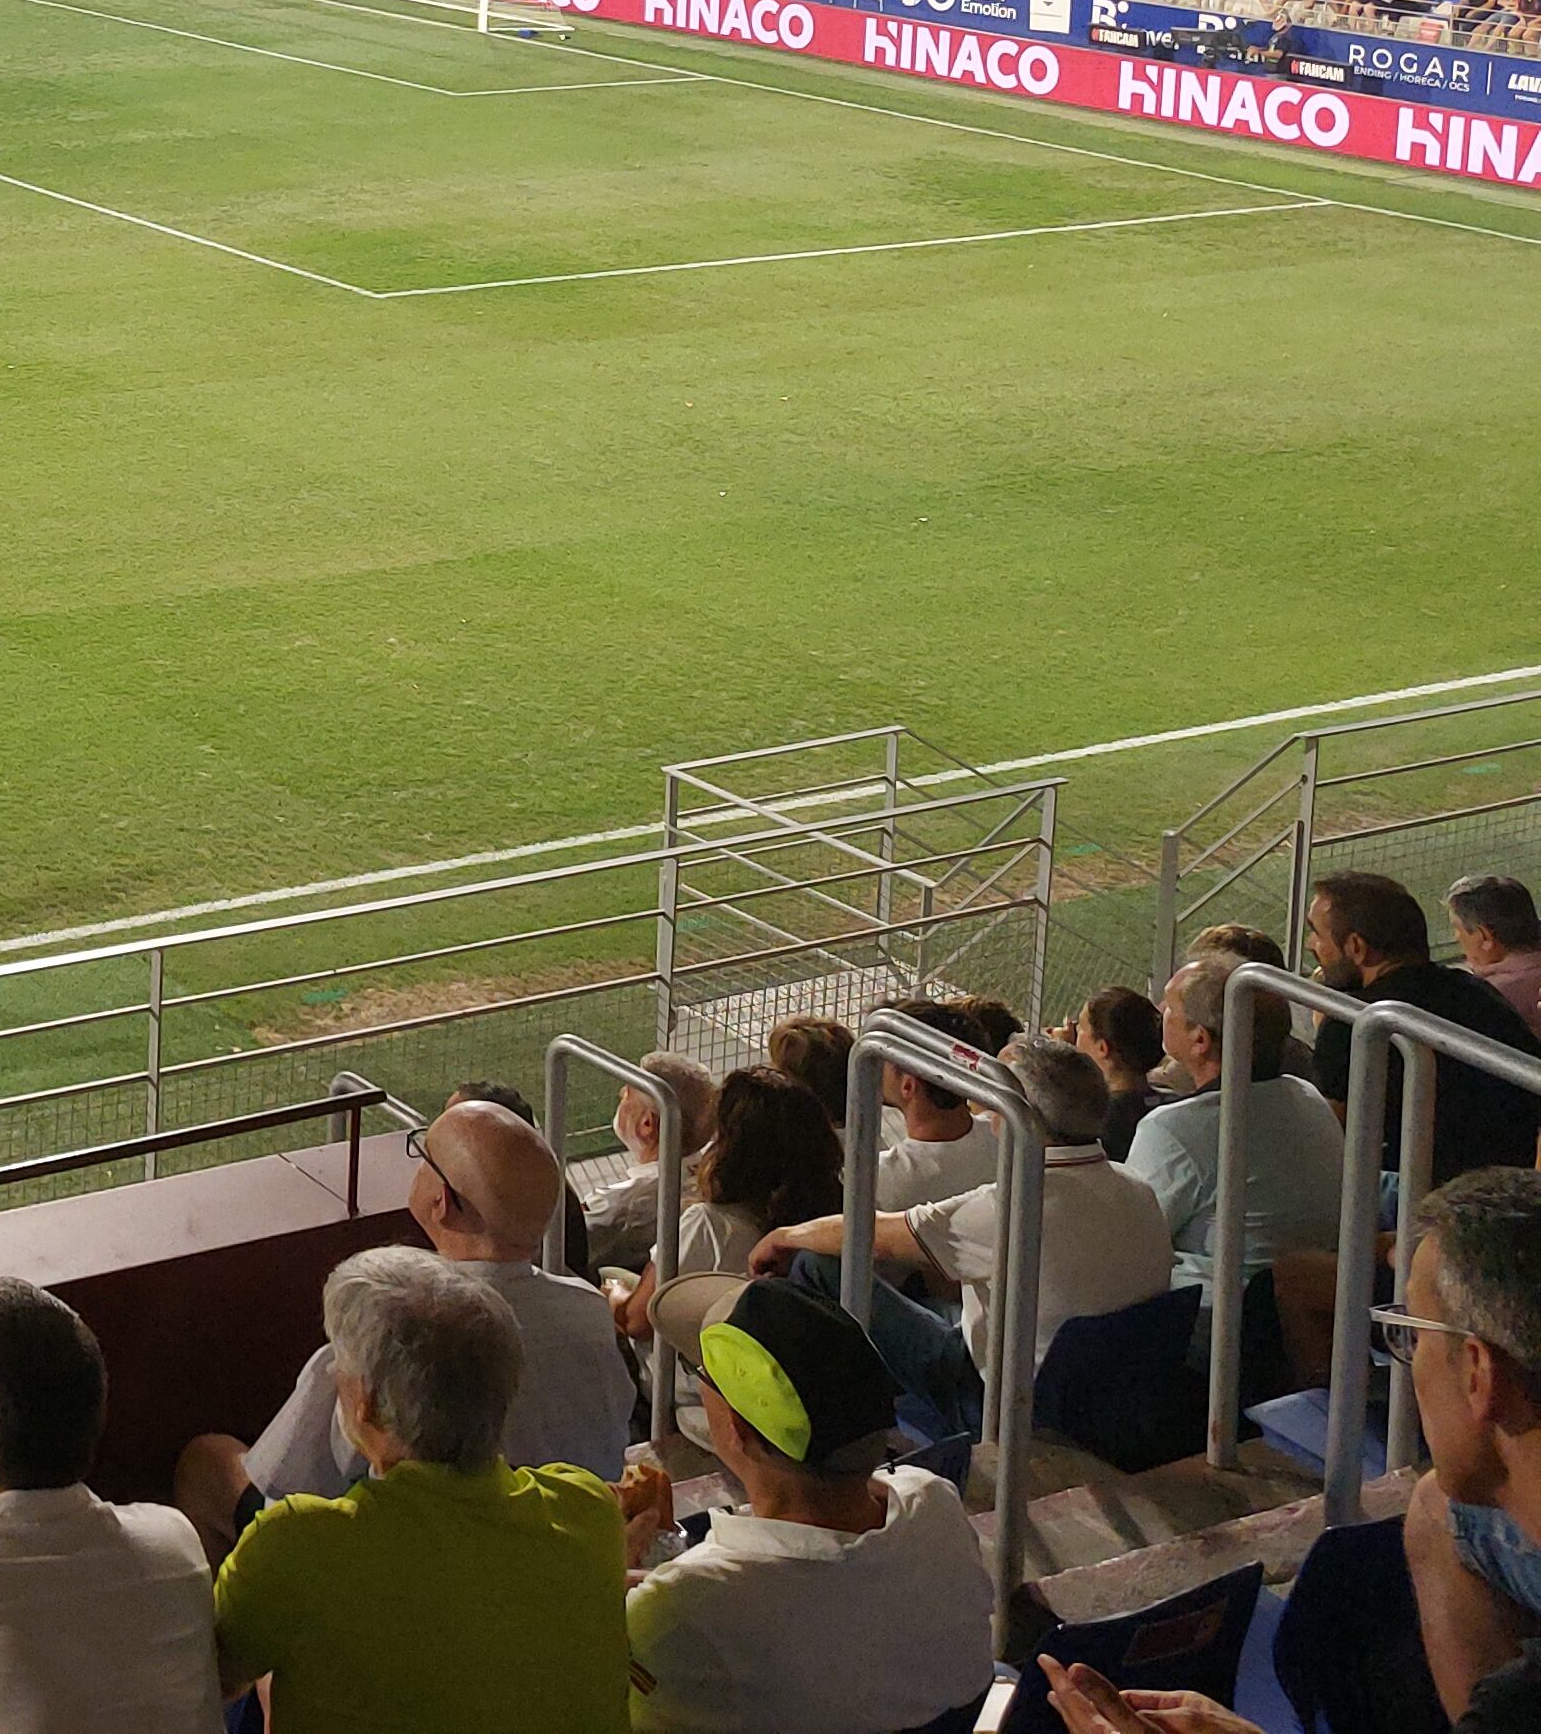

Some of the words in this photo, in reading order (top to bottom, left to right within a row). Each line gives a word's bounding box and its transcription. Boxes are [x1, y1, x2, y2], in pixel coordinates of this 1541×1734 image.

[960, 0, 1017, 21] Emotion
[863, 17, 1060, 96] HINACO
[1348, 43, 1470, 83] ROGAR
[1353, 66, 1392, 80] ENDING
[1399, 72, 1441, 89] HORECA
[1448, 81, 1470, 93] OCS
[1508, 73, 1541, 95] LAV
[1117, 60, 1350, 148] HINACO
